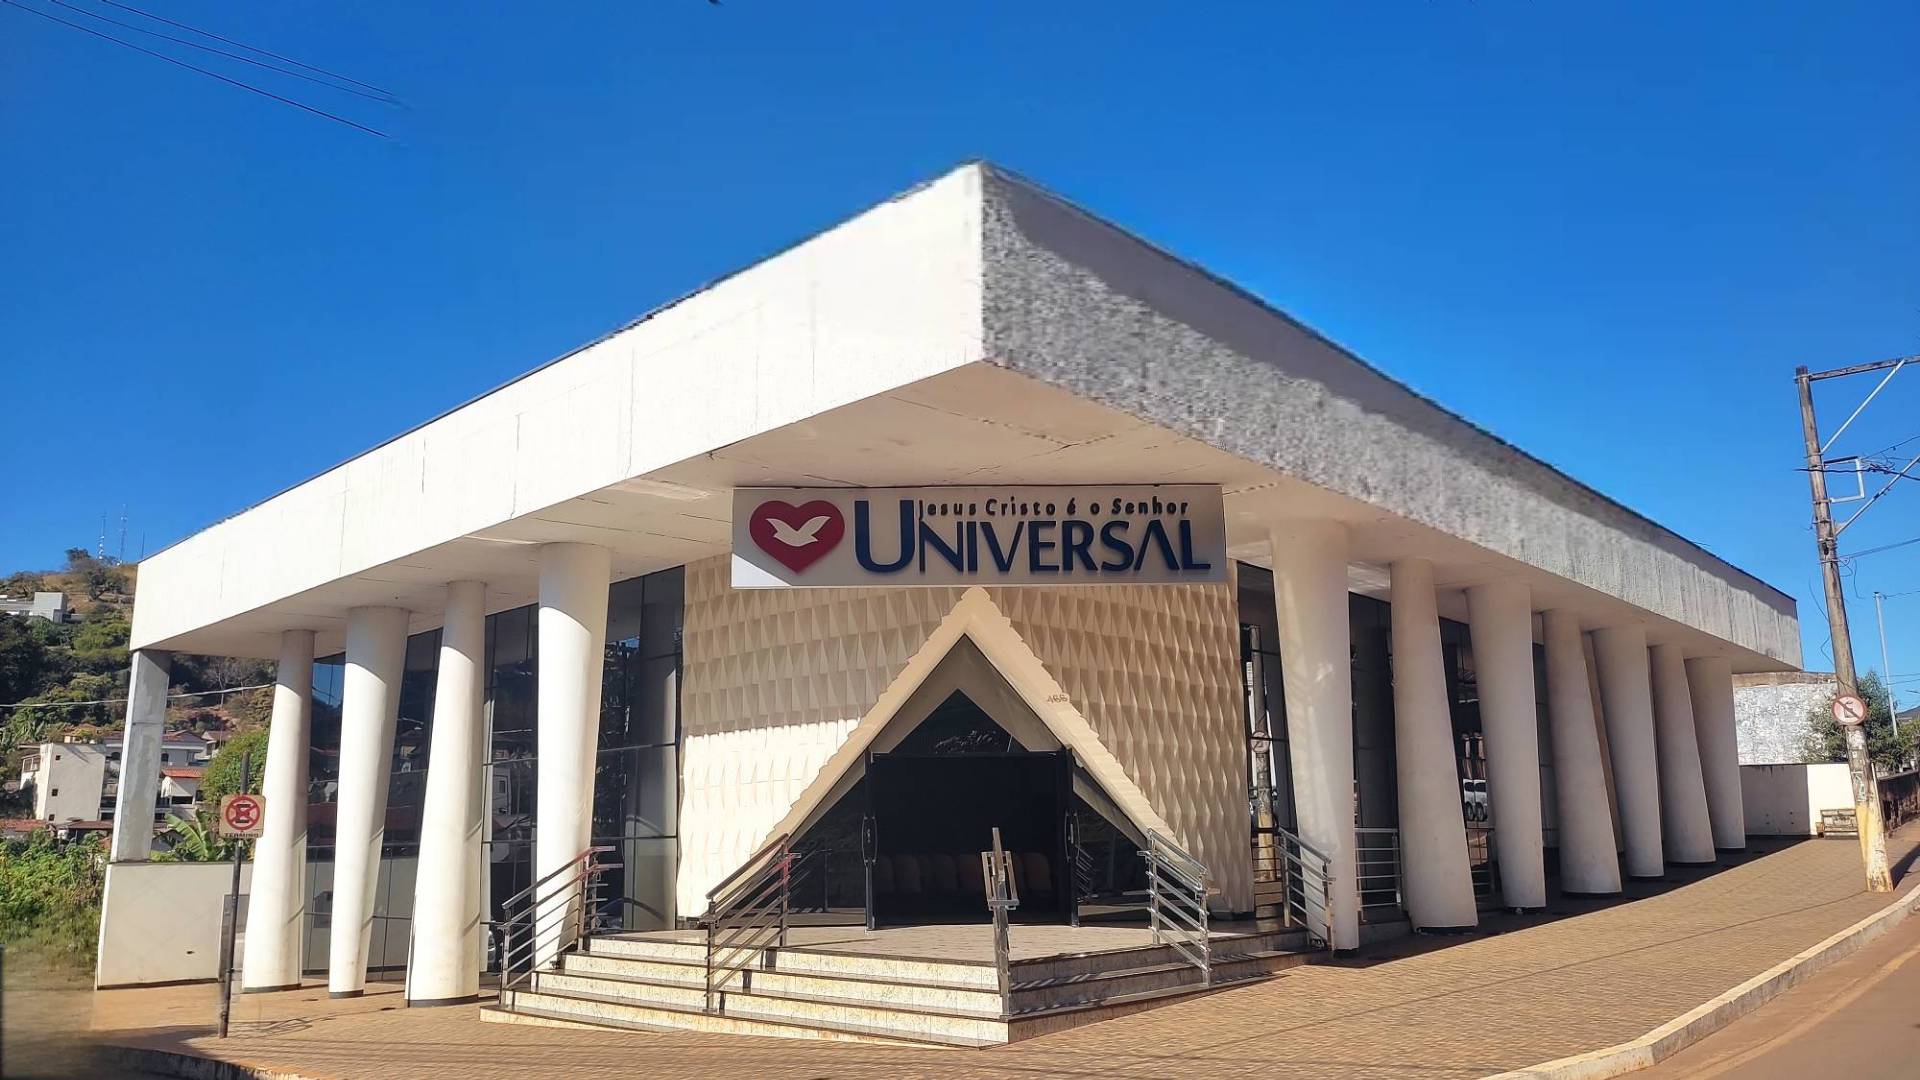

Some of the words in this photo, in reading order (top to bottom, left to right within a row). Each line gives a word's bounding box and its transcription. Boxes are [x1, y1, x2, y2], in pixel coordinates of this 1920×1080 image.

[919, 500, 977, 520] Jesus
[985, 496, 1056, 516] Cristo
[1067, 498, 1076, 515] é
[1090, 502, 1100, 515] o
[1111, 496, 1188, 515] Senhor
[854, 499, 1212, 573] UNIVERSAL
